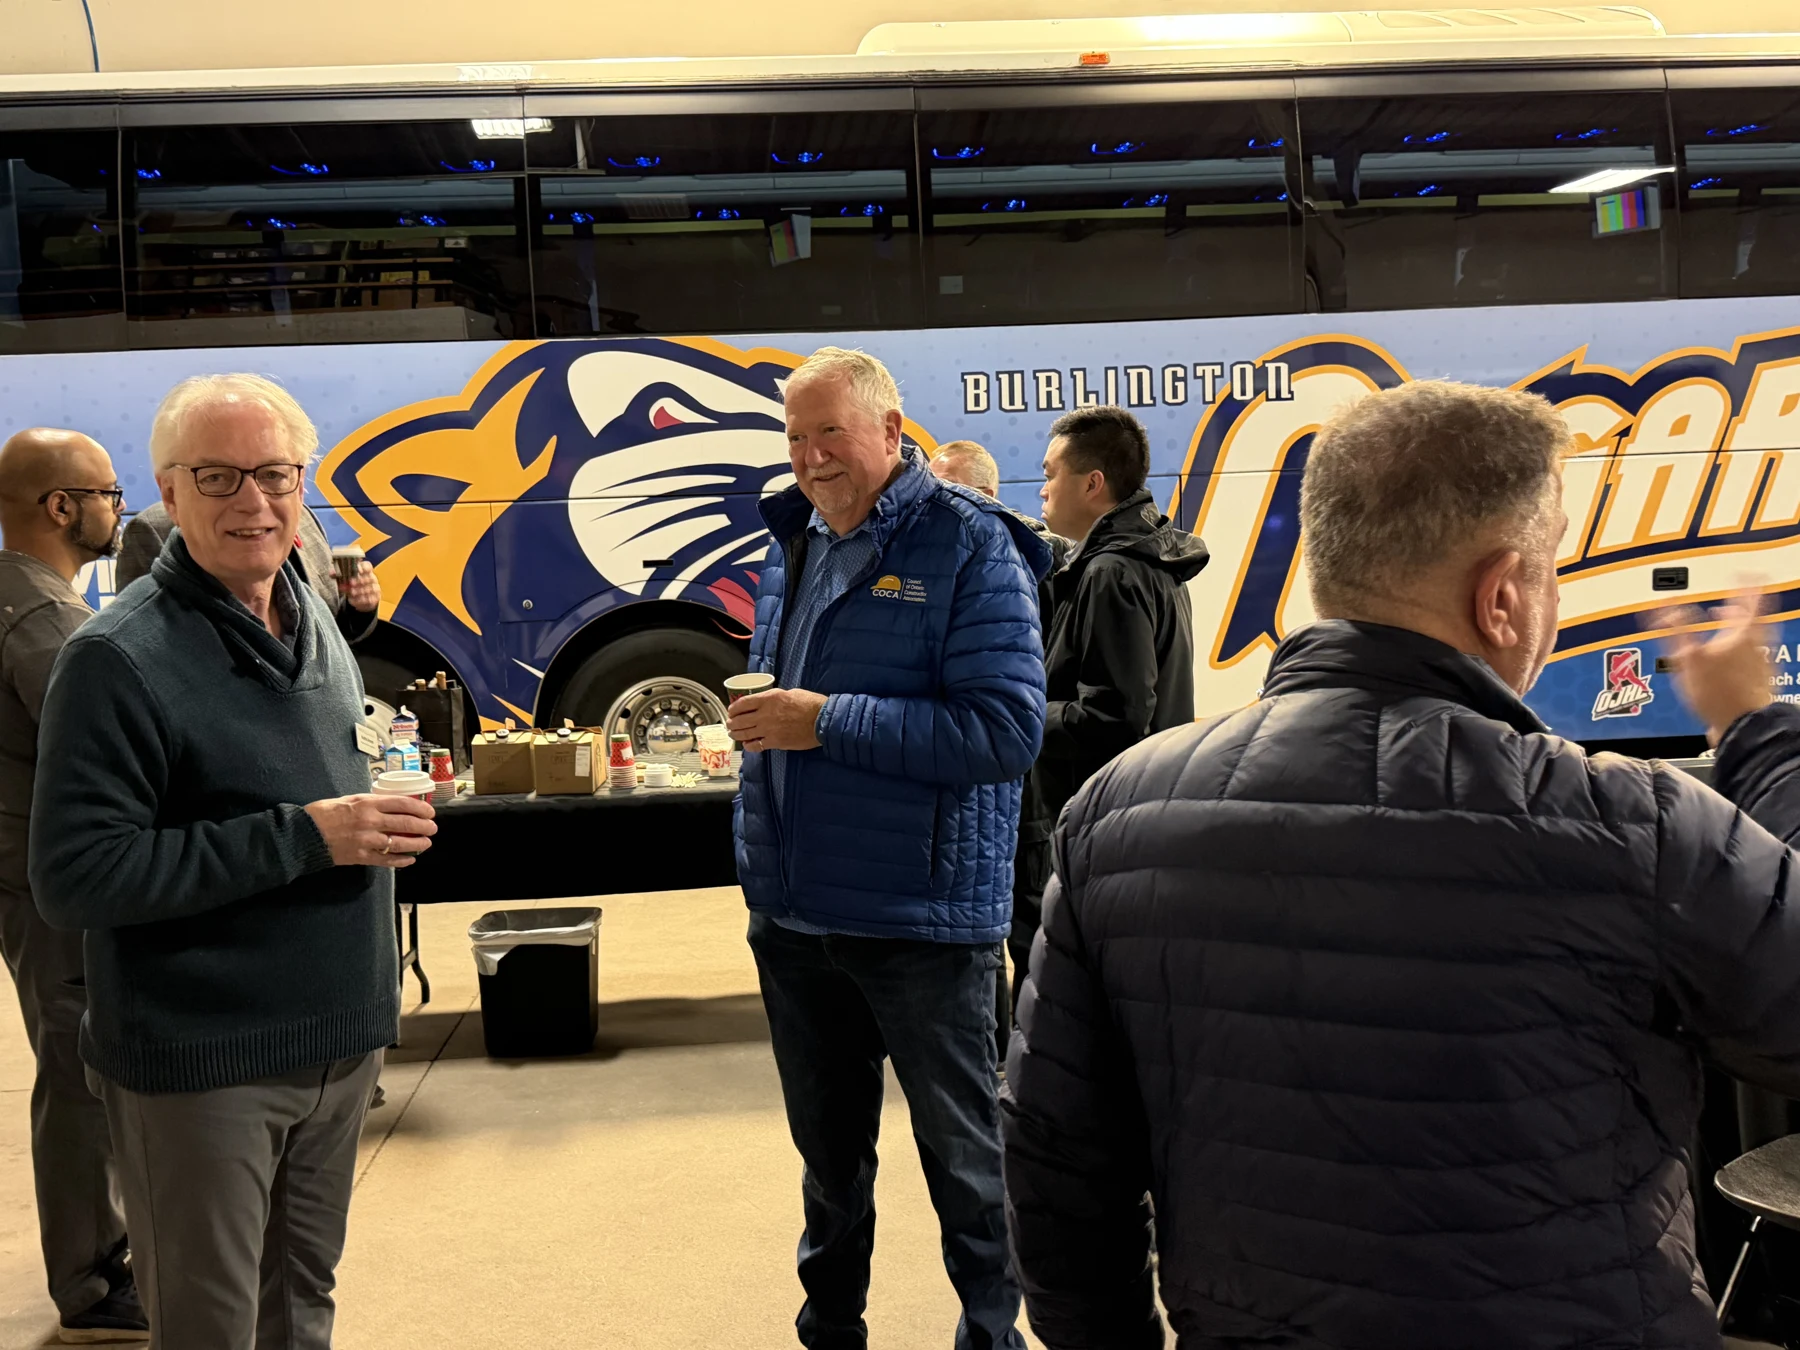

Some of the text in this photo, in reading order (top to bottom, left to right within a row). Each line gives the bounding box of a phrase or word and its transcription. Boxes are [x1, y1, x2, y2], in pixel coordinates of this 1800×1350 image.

[961, 361, 1295, 414] BURLINGTON
[872, 589, 898, 599] COCA
[1596, 684, 1649, 713] OJHL
